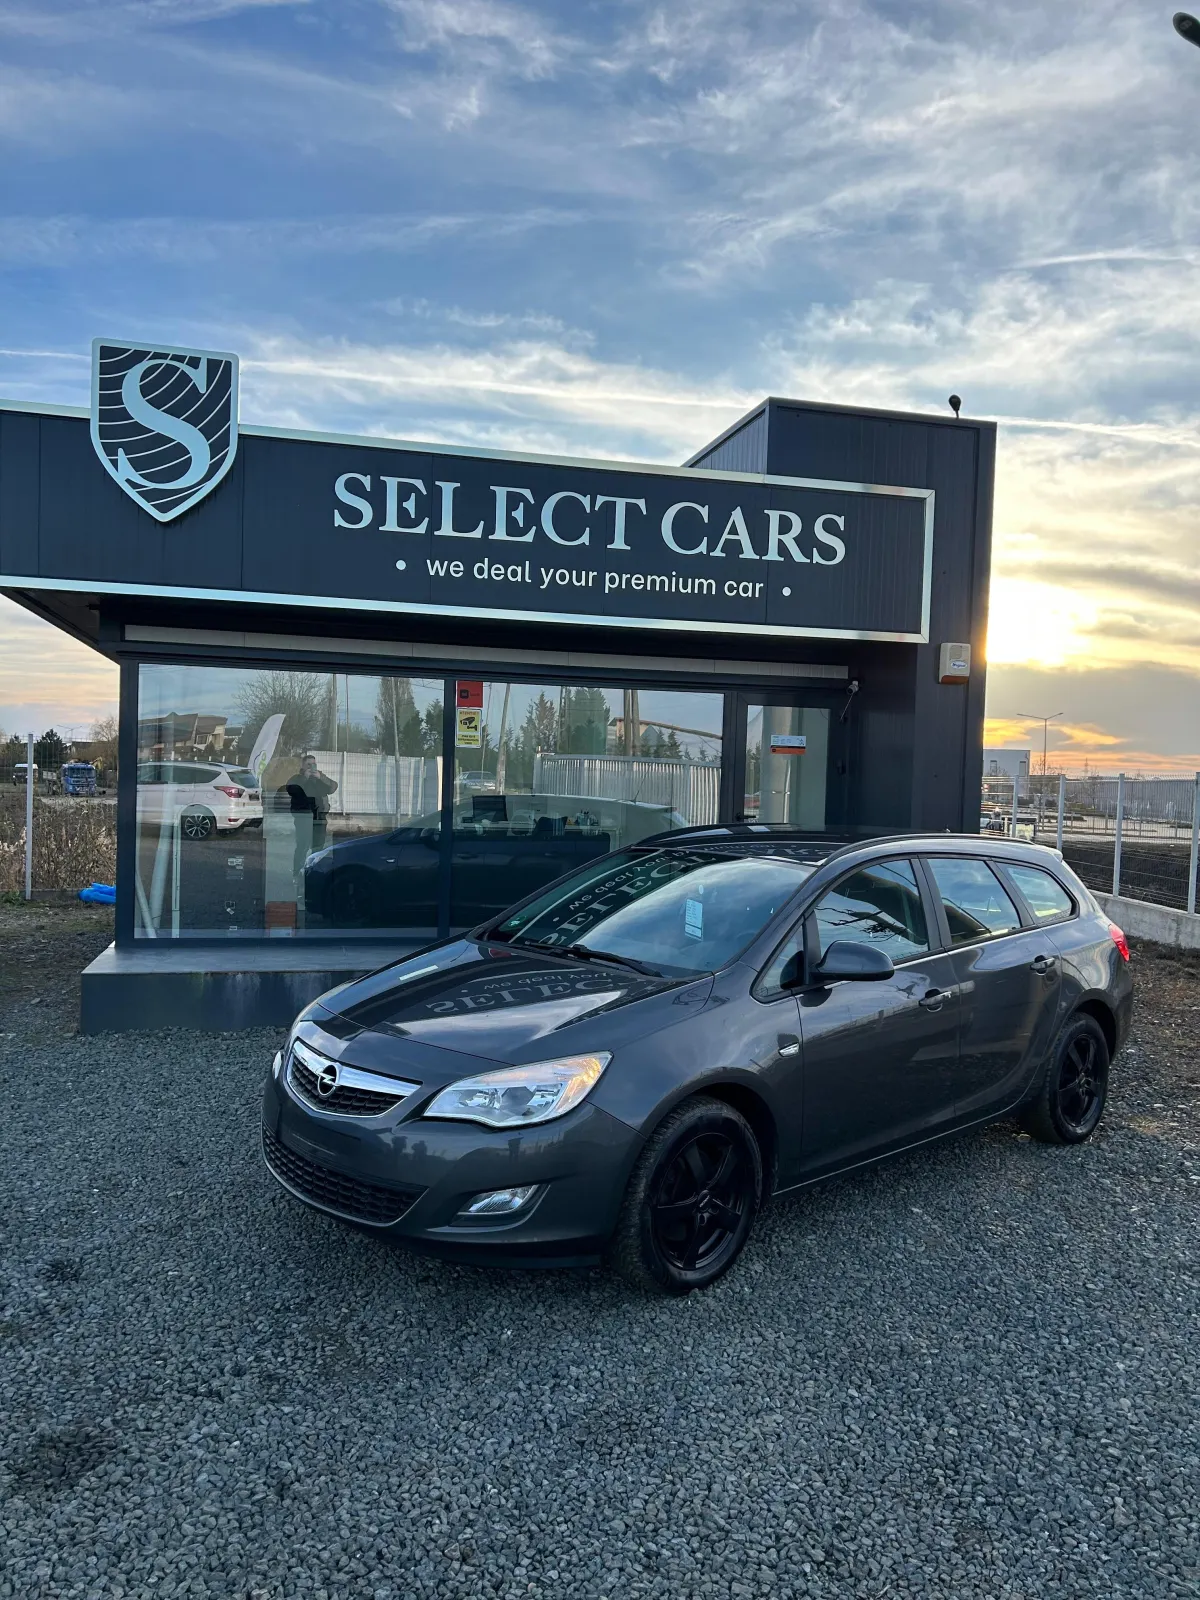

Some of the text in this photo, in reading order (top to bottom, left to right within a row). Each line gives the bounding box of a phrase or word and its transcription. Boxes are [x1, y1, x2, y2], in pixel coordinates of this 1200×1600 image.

[116, 356, 210, 490] S
[334, 472, 847, 566] SELECT CARS
[426, 557, 764, 598] we deal your premium car
